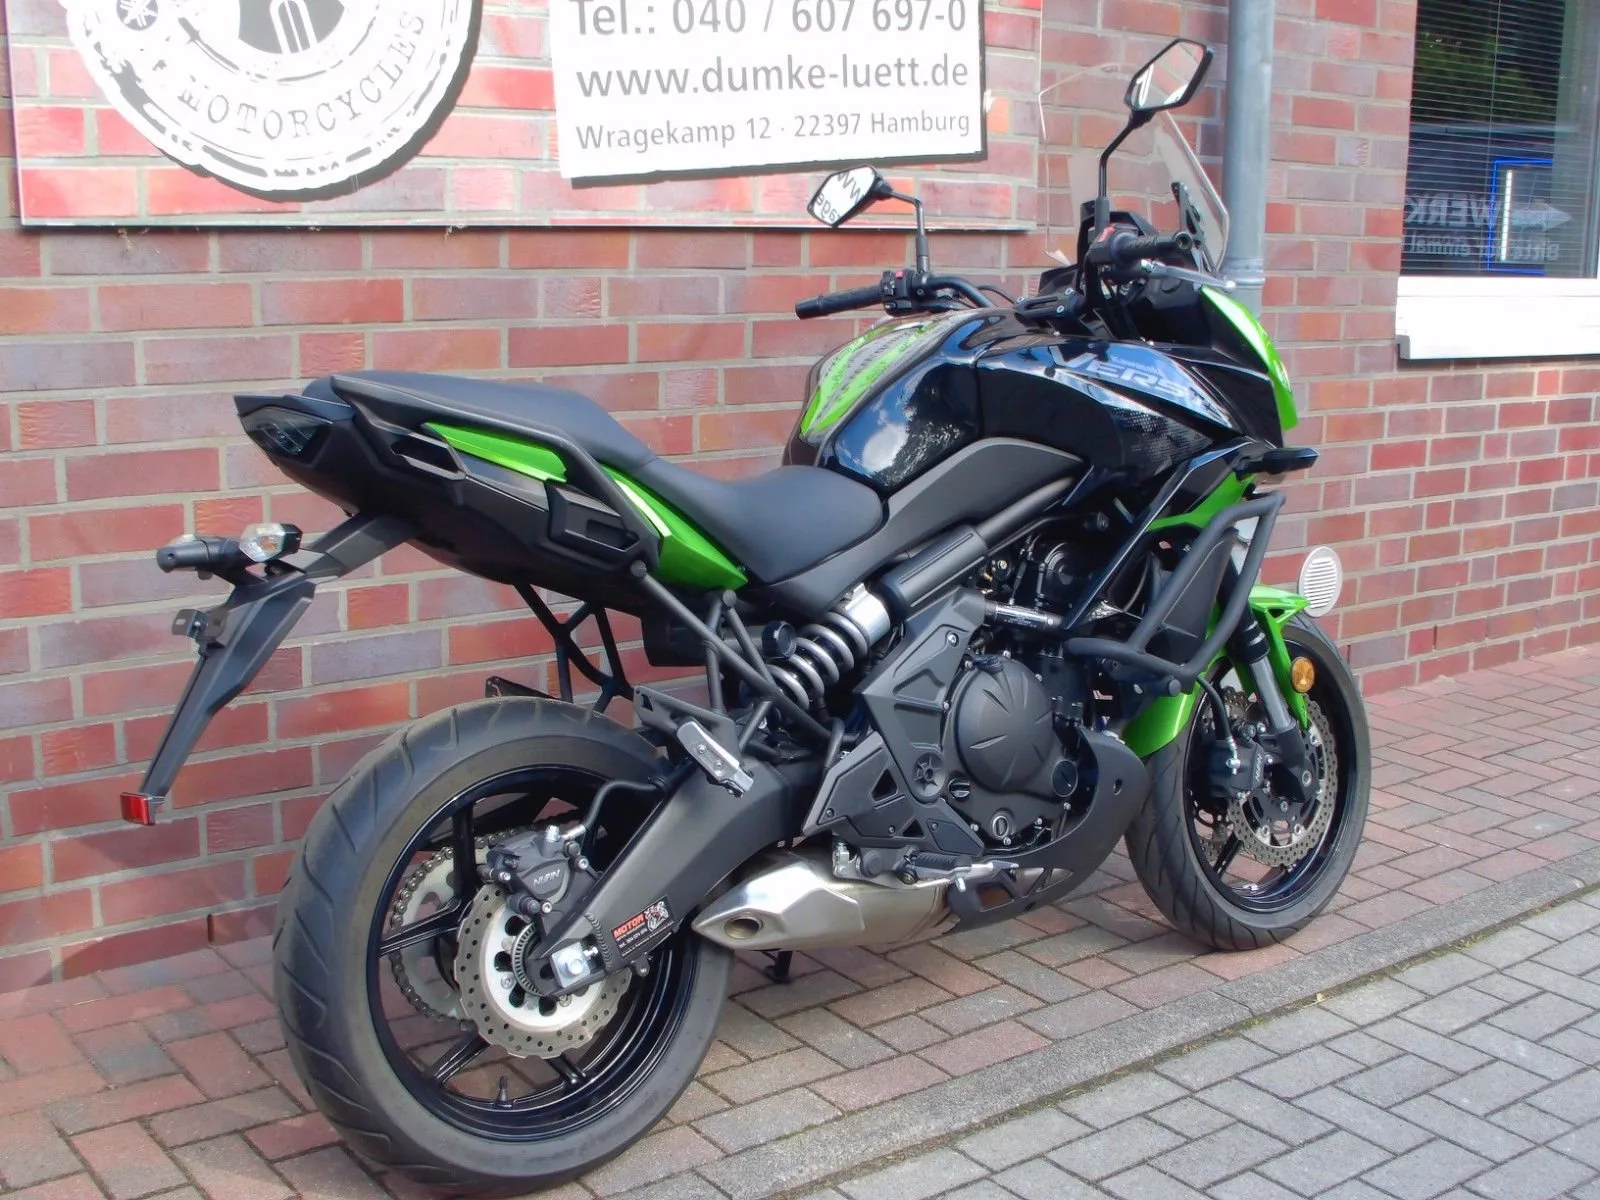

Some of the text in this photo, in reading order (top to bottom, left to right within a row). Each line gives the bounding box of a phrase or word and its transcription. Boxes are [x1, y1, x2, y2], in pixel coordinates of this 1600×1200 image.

[569, 0, 655, 35] Tel.:
[673, 0, 746, 34] 040
[792, 0, 855, 32] 607
[872, 0, 966, 31] 697-0
[576, 53, 968, 97] www.dumke-luett.de
[576, 120, 735, 153] Wragekamp
[746, 117, 771, 139] 12
[794, 113, 861, 137] 22397
[871, 109, 969, 136] Hamburg
[1049, 345, 1218, 416] VERS
